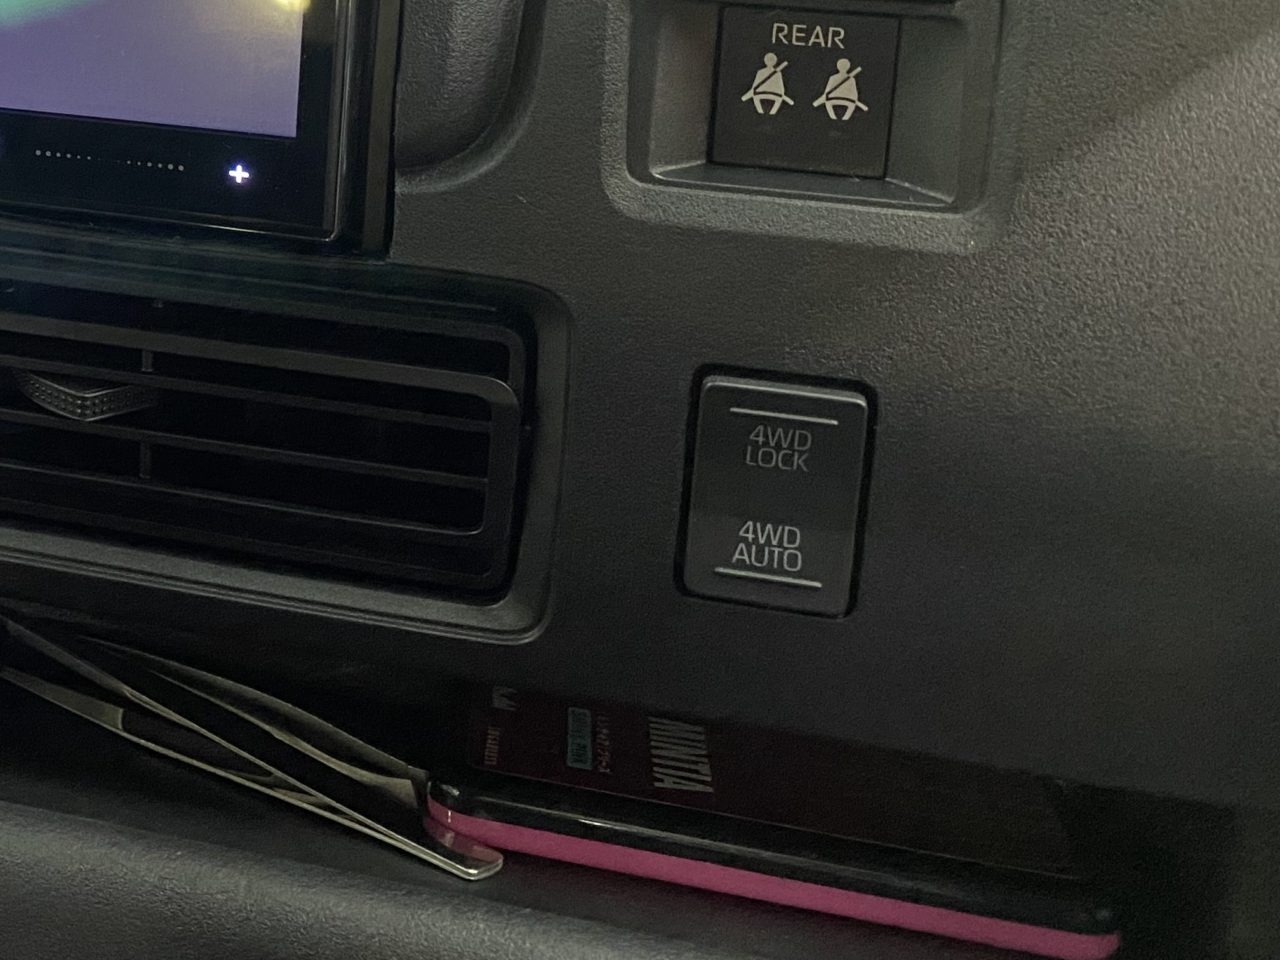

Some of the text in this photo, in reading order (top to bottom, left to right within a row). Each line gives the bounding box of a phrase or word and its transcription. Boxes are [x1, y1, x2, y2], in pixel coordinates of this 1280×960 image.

[772, 22, 846, 49] REAR
[749, 424, 812, 451] 4WD
[745, 445, 810, 472] LOCK
[738, 520, 801, 548] 4WD
[731, 542, 802, 572] AUTO
[648, 716, 715, 793] MINTIA
